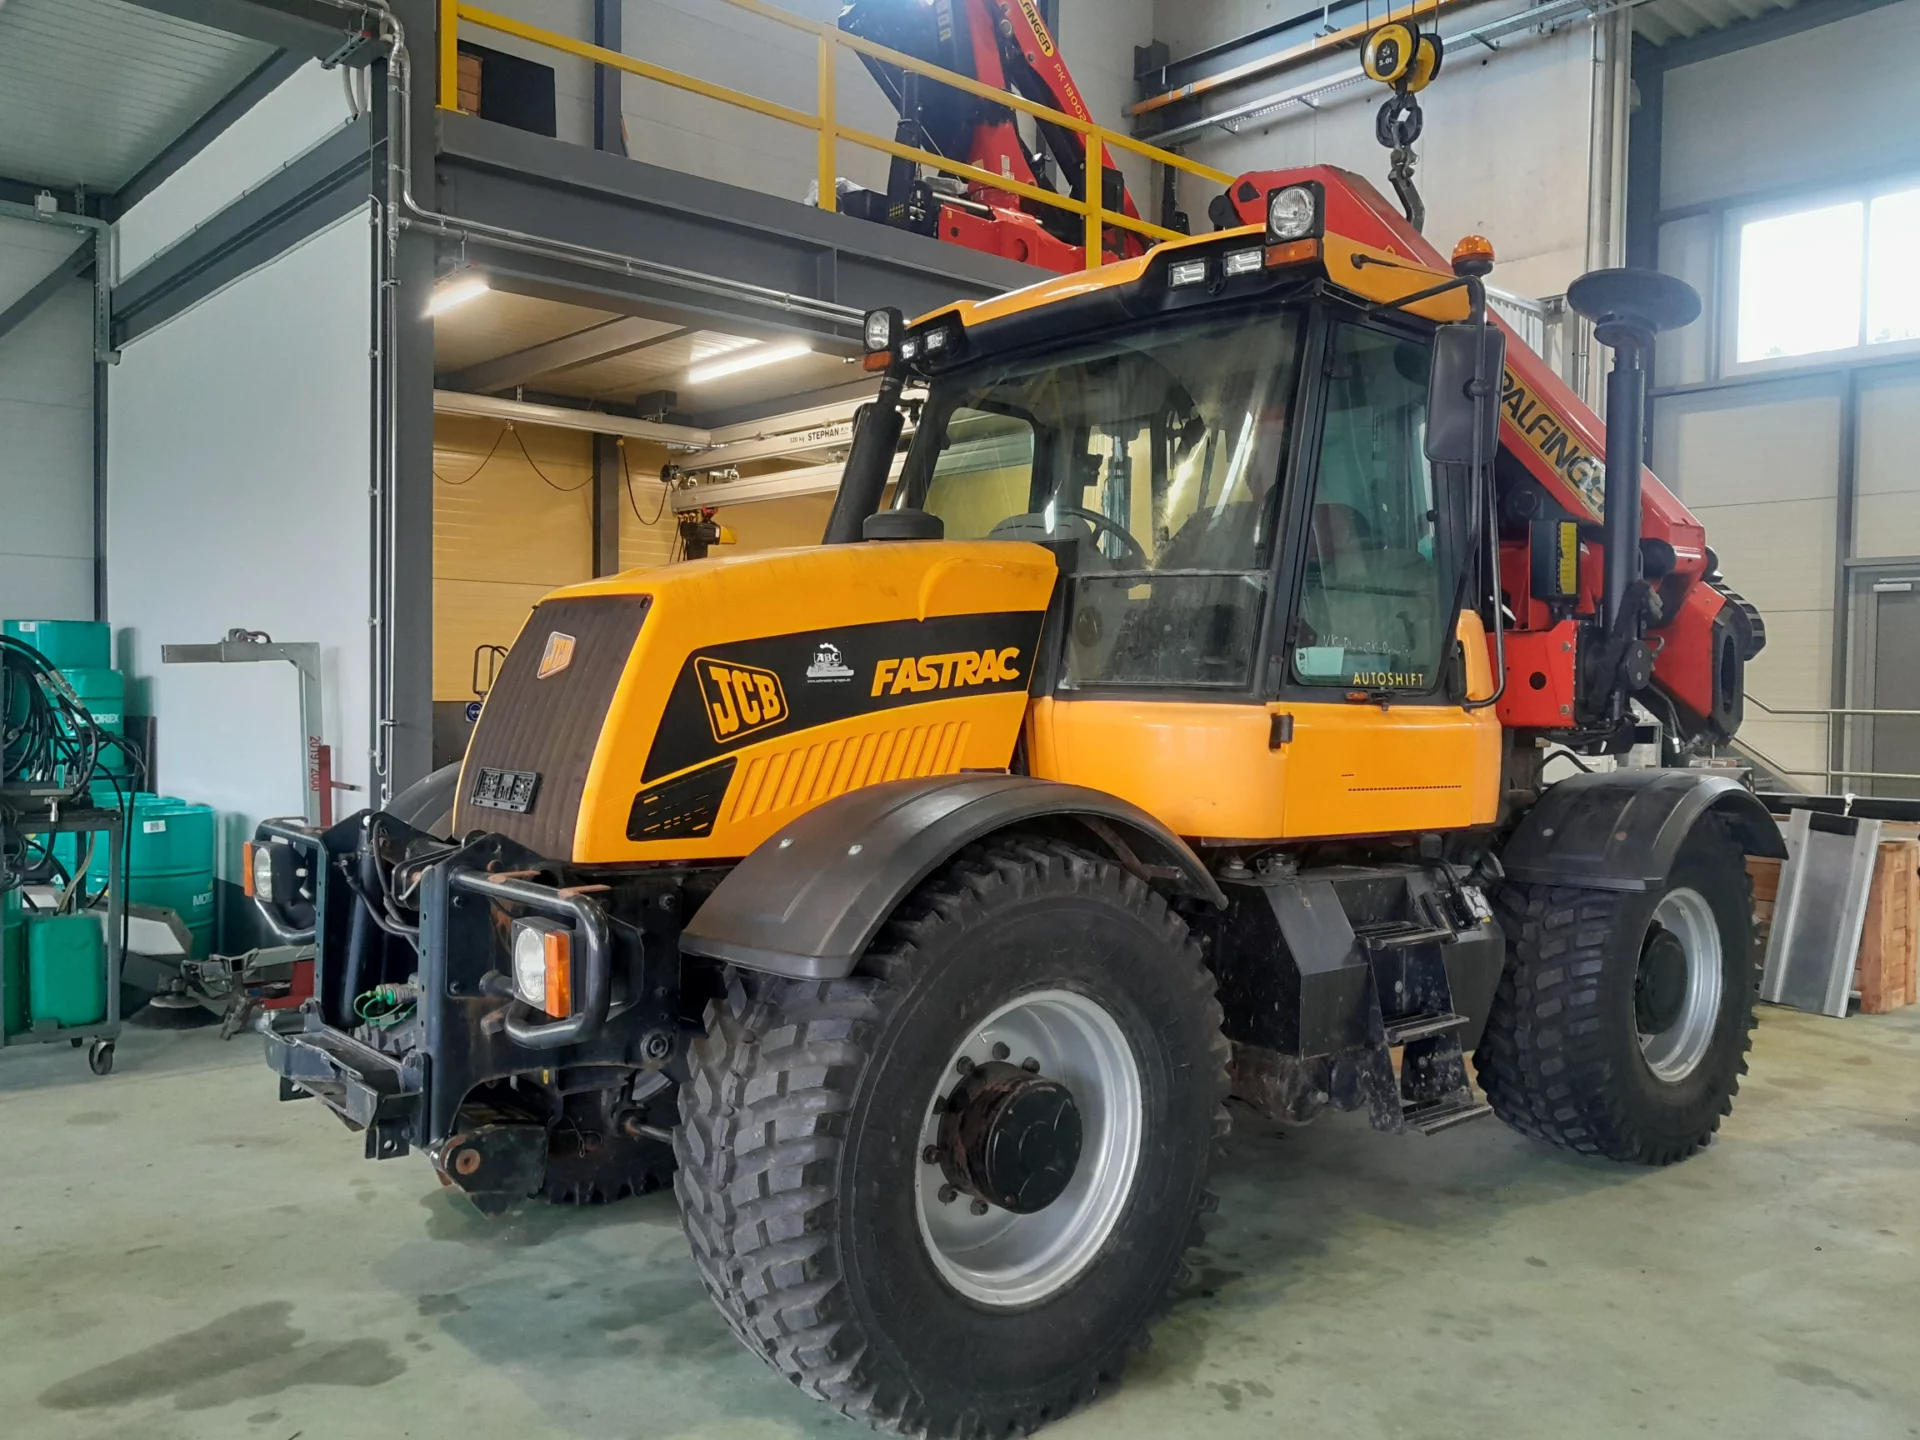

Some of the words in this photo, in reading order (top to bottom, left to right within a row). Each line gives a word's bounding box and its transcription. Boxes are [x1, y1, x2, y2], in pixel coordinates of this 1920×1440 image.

[1053, 63, 1066, 82] PK
[807, 427, 839, 442] STEPHAN
[816, 652, 840, 662] ABC
[870, 647, 1021, 697] FASTRAC
[1352, 671, 1424, 686] AUTOSHIFT
[709, 665, 781, 735] JCB
